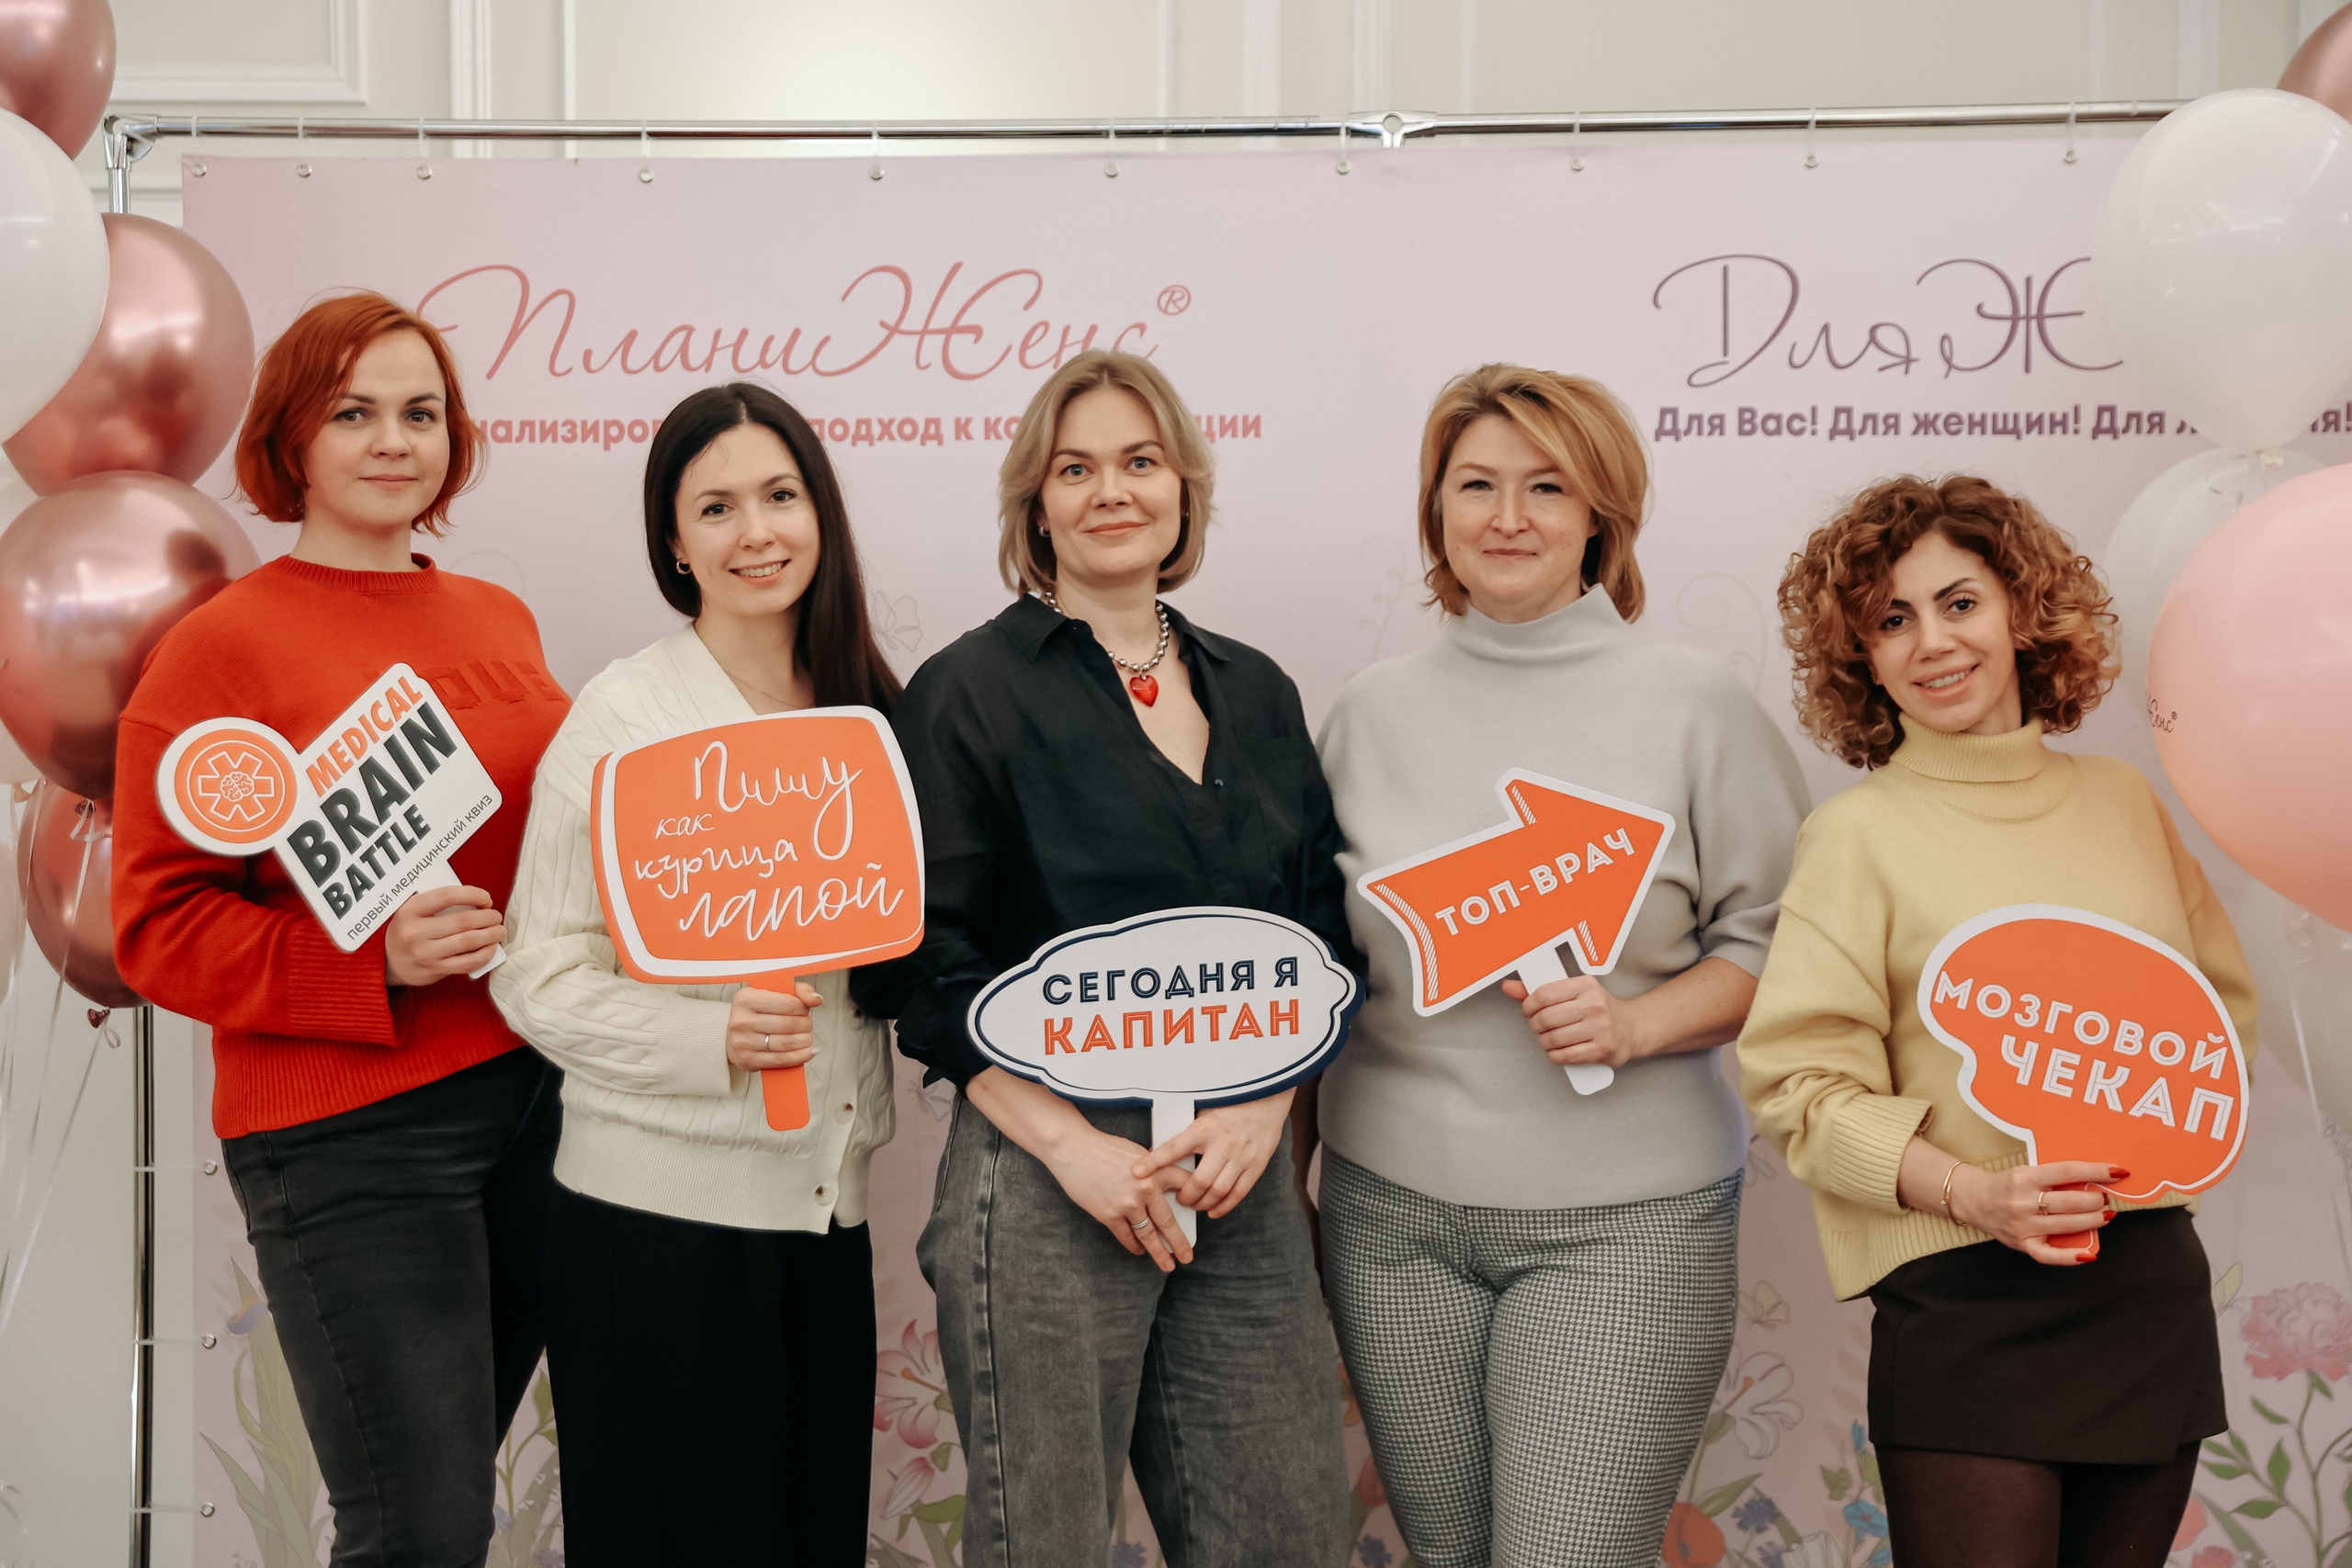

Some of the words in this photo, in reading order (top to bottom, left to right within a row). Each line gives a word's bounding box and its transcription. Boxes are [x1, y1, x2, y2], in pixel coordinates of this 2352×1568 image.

[808, 416, 944, 446] подход
[954, 416, 974, 441] к
[1655, 407, 1725, 441] Для
[1737, 407, 1818, 436] Вас!
[1829, 406, 1901, 440] Для
[1911, 405, 2081, 440] женщин!
[2092, 404, 2166, 439] Для
[305, 676, 424, 797] MEDICAL
[287, 701, 458, 887] BRAIN
[655, 813, 715, 840] как
[695, 740, 863, 861] Пишу
[322, 804, 432, 920] BATTLE
[347, 892, 392, 941] первый
[391, 818, 468, 898] медицинский
[465, 795, 493, 824] квиз
[635, 839, 798, 899] курица
[680, 863, 905, 942] лапой
[1435, 828, 1635, 936] ТОП-ВРАЧ
[1043, 959, 1255, 1006] СЕГОДНЯ
[1273, 956, 1298, 988] Я
[1044, 998, 1300, 1055] КАПИТАН
[1934, 970, 2228, 1080] МОЗГОВОЙ
[2000, 1033, 2234, 1142] ЧЕКАП
